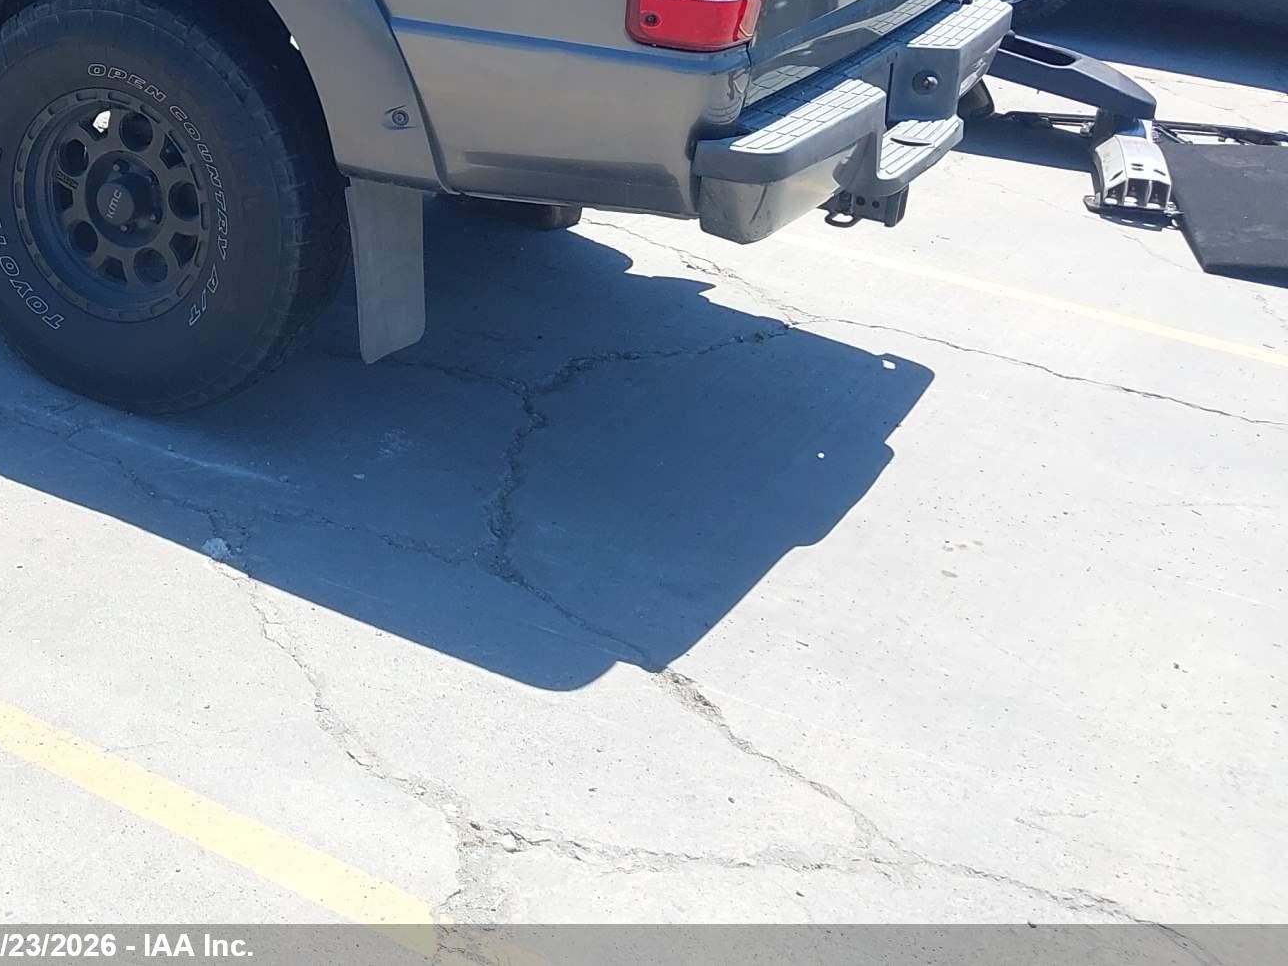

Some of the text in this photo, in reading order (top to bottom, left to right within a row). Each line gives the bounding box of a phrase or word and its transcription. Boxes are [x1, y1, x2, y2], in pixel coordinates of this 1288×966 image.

[88, 64, 229, 326] OPEN COUNTRY A/T
[0, 255, 64, 330] TOYO
